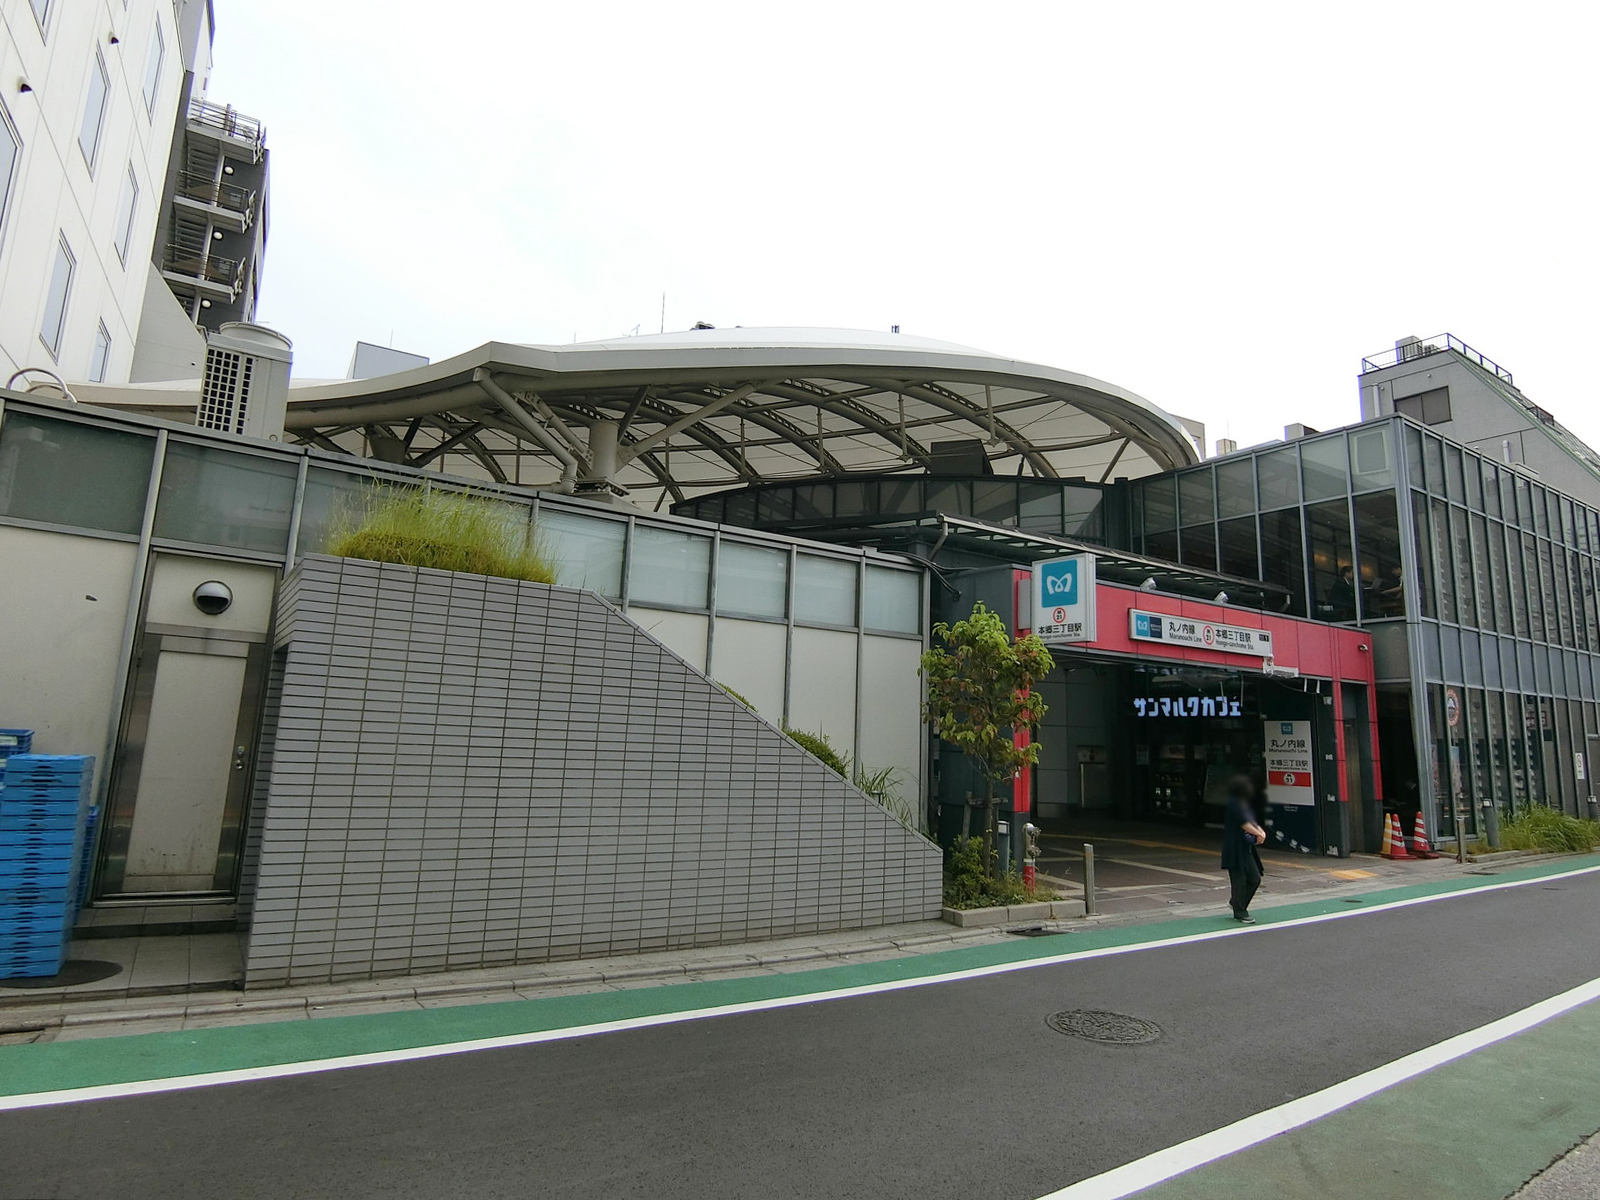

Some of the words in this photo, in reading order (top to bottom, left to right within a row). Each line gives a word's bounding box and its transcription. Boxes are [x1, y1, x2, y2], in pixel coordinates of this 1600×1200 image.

[1038, 622, 1083, 634] 本郷三丁目駅
[1168, 621, 1196, 635] 丸ノ内線
[1169, 632, 1193, 641] Marunouchi
[1215, 629, 1252, 643] 本郷三丁目駅
[1133, 696, 1241, 717] サンマルクカフェ
[1270, 739, 1306, 748] 丸ノ内線
[1270, 759, 1308, 767] 本郷三丁目駅
